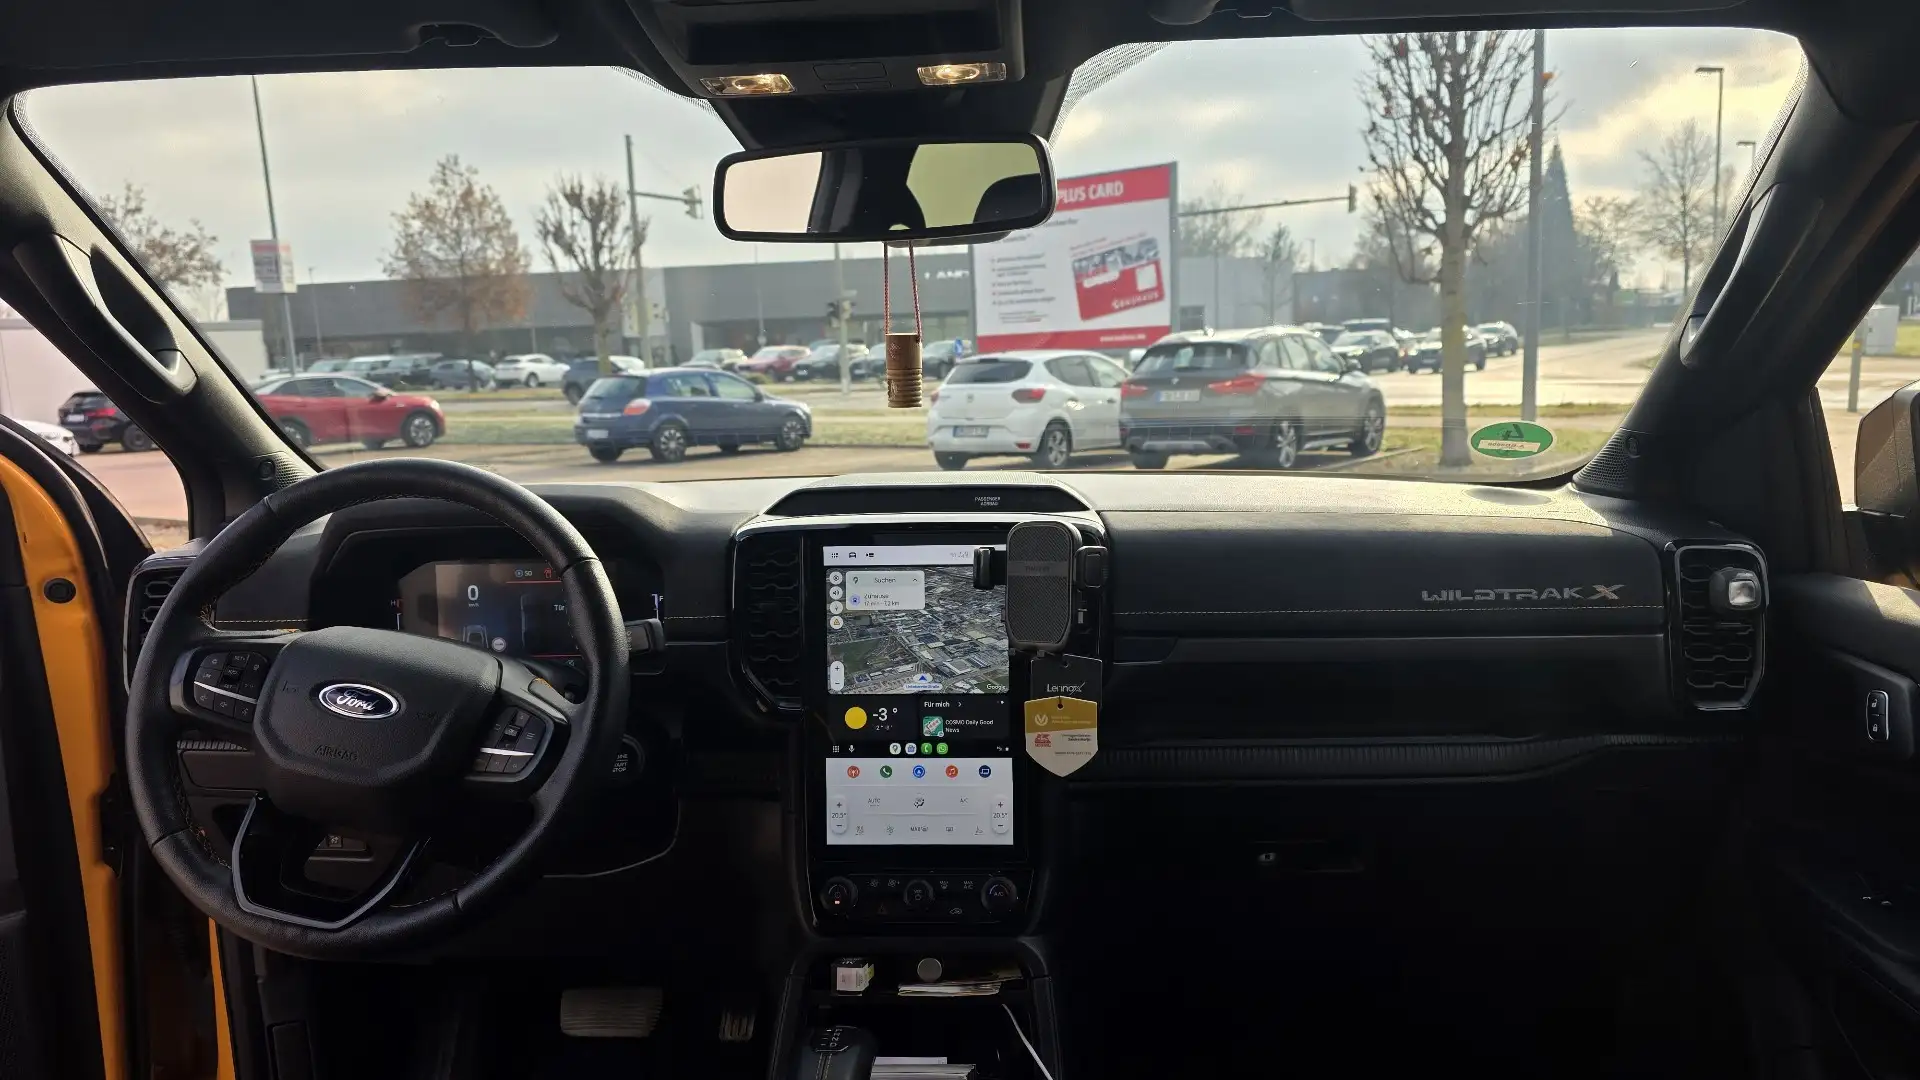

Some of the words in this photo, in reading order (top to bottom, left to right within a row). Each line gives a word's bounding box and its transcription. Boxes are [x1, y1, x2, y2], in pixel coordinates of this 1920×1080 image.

[1057, 186, 1087, 204] PLUS
[1088, 180, 1124, 200] CARD
[467, 584, 479, 601] 0
[1421, 586, 1583, 602] WILDTRAK
[1591, 584, 1625, 601] X
[1046, 681, 1086, 696] Lennox
[336, 689, 379, 712] Ford
[314, 744, 358, 761] AIRBAG
